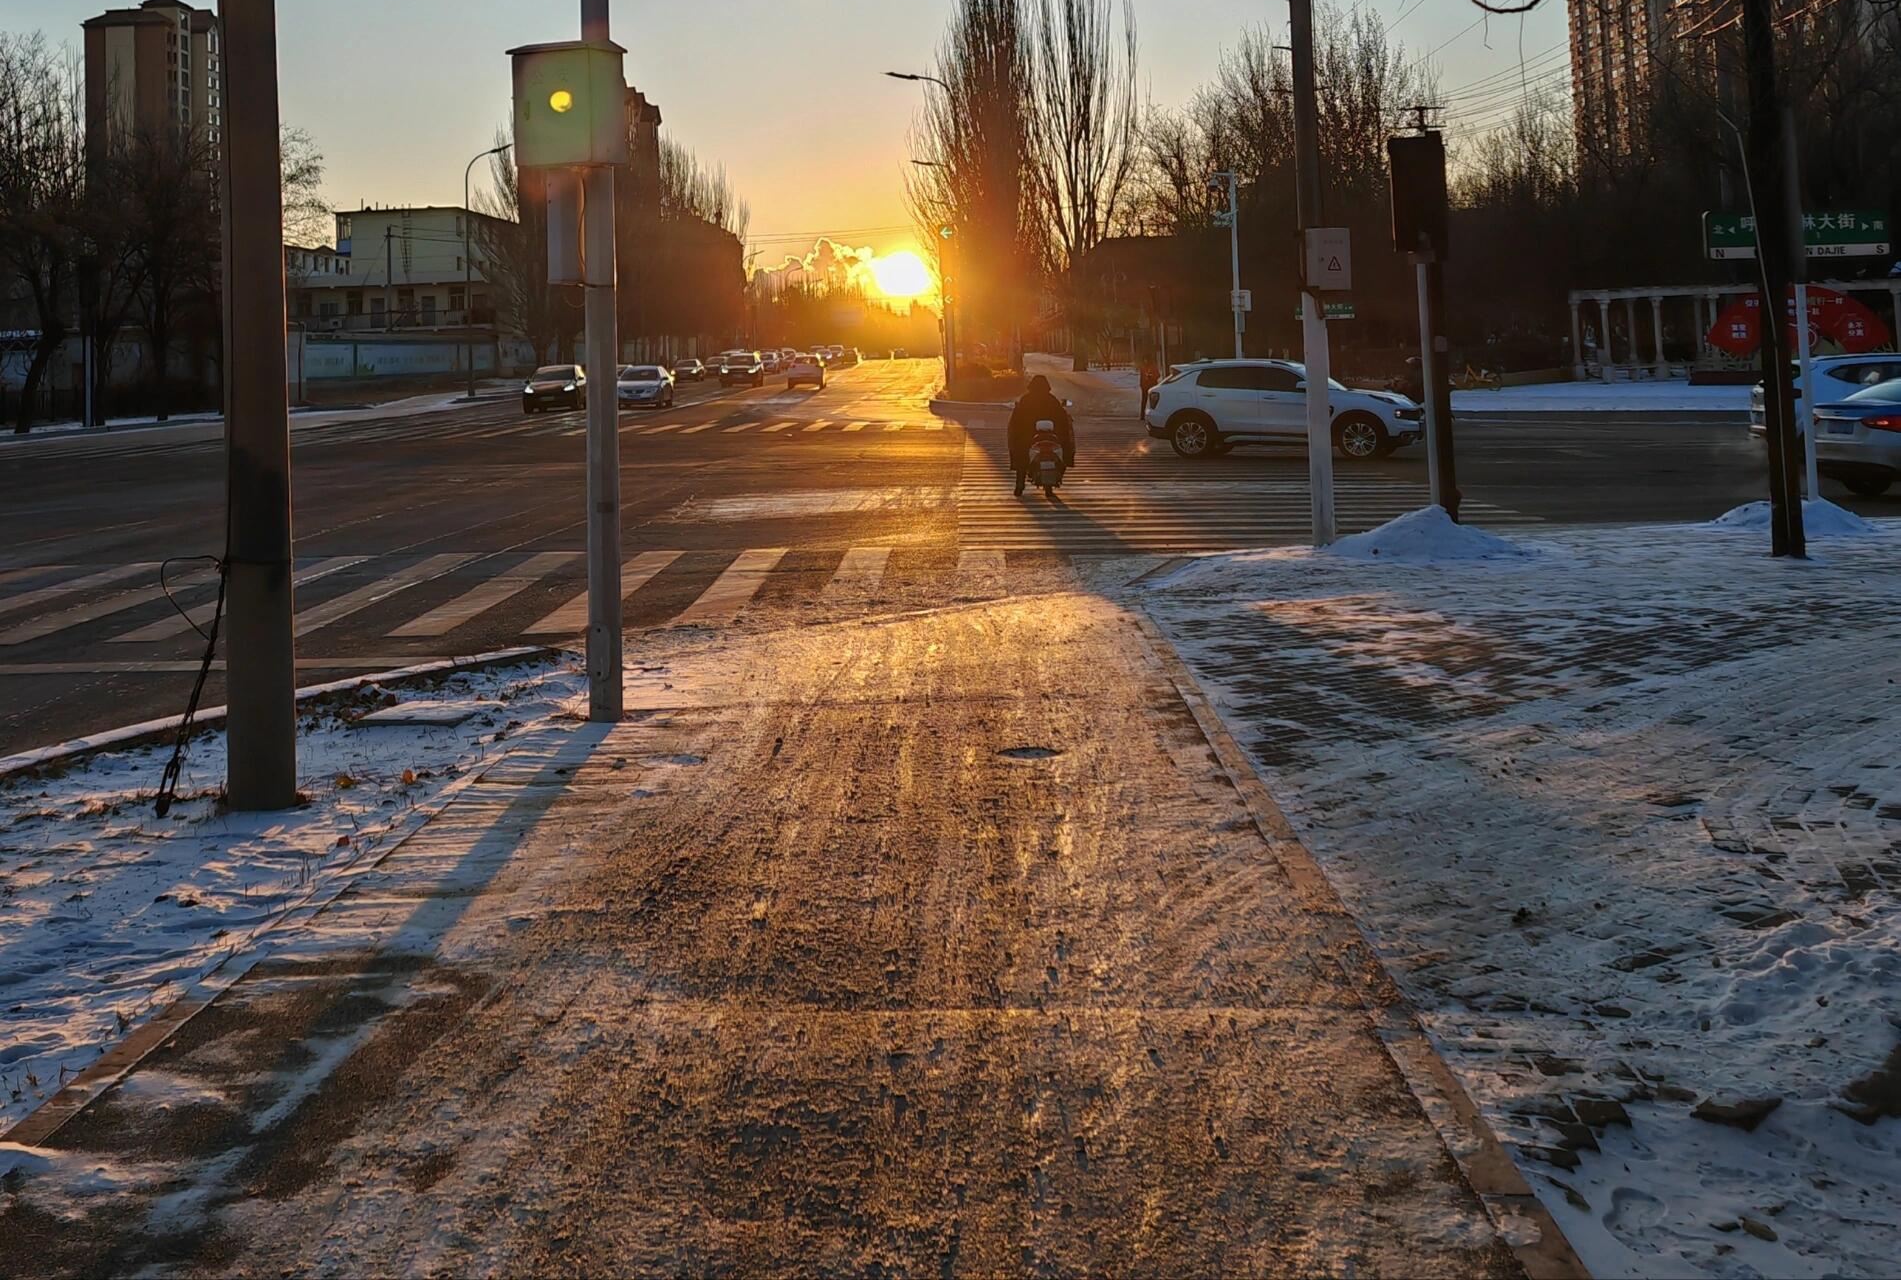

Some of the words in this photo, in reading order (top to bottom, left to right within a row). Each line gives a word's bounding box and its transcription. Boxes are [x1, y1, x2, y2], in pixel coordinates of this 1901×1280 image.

[1715, 248, 1725, 258] N
[1817, 246, 1847, 255] DAJIE
[1876, 244, 1884, 254] S
